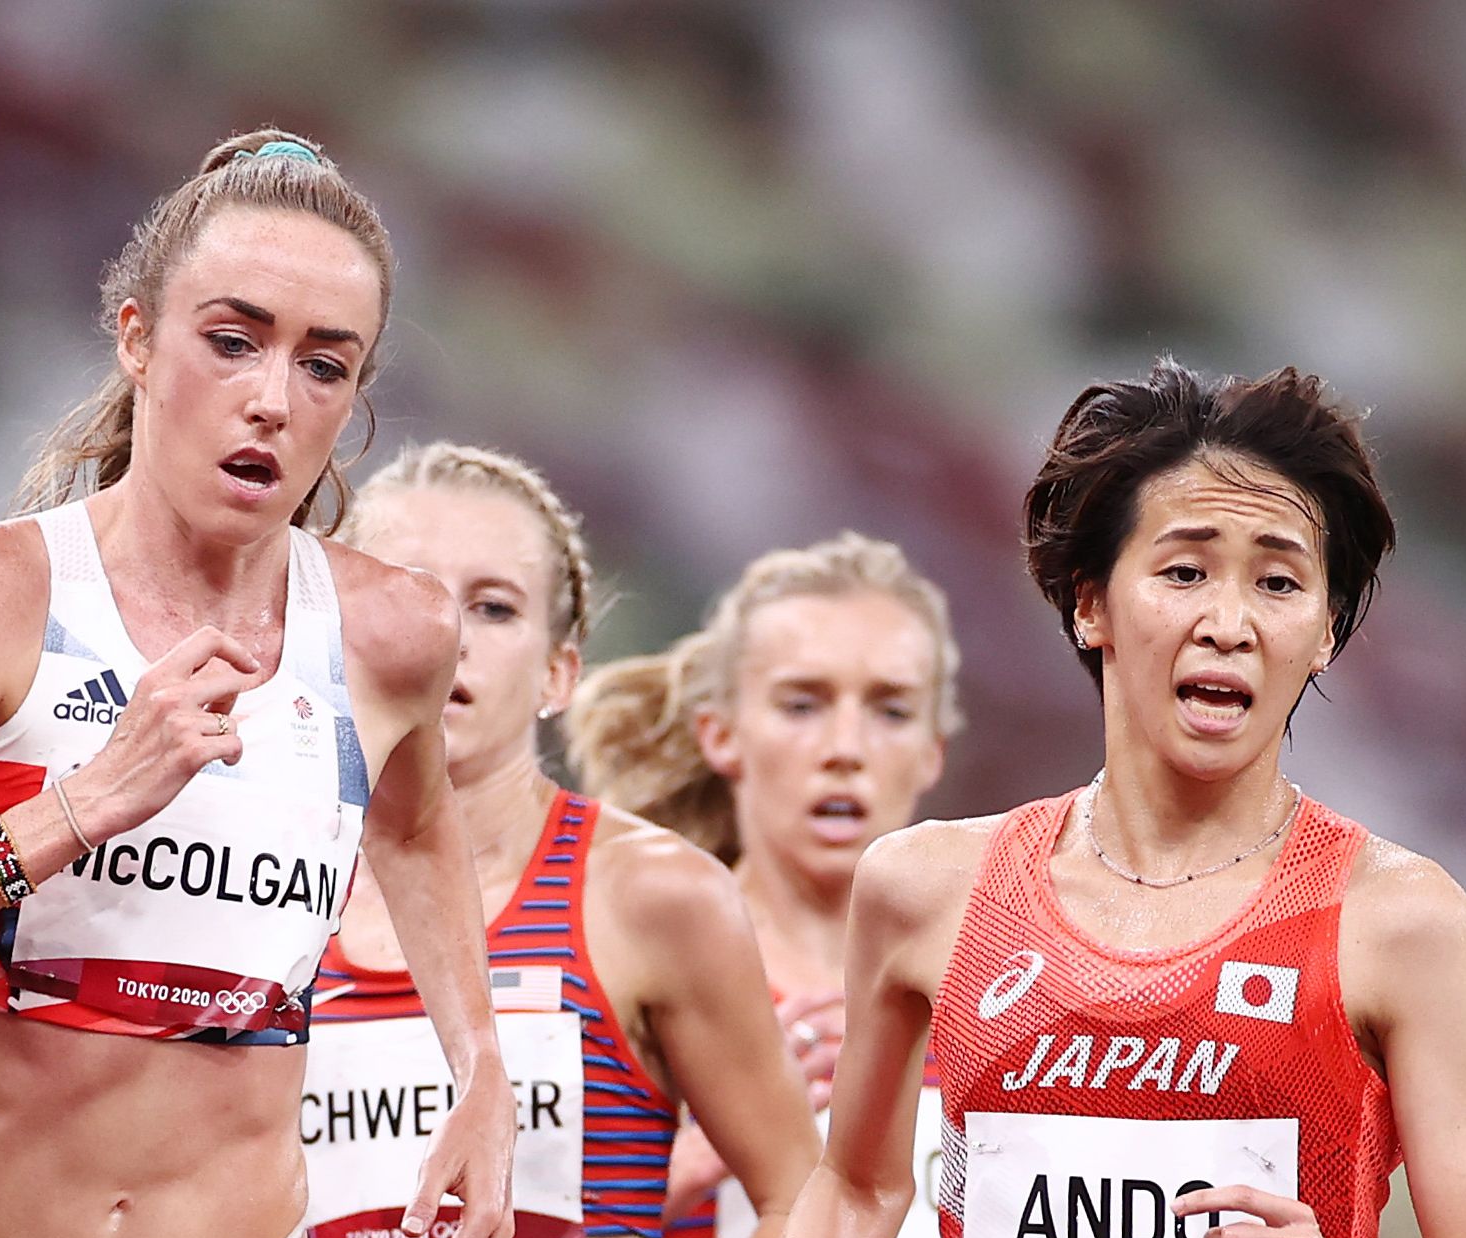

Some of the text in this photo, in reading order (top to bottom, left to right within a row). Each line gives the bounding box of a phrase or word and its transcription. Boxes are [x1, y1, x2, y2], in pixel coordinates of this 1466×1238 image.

[53, 701, 122, 725] adid
[117, 977, 211, 1007] TOKYO 2020
[1001, 1034, 1241, 1096] JAPAN
